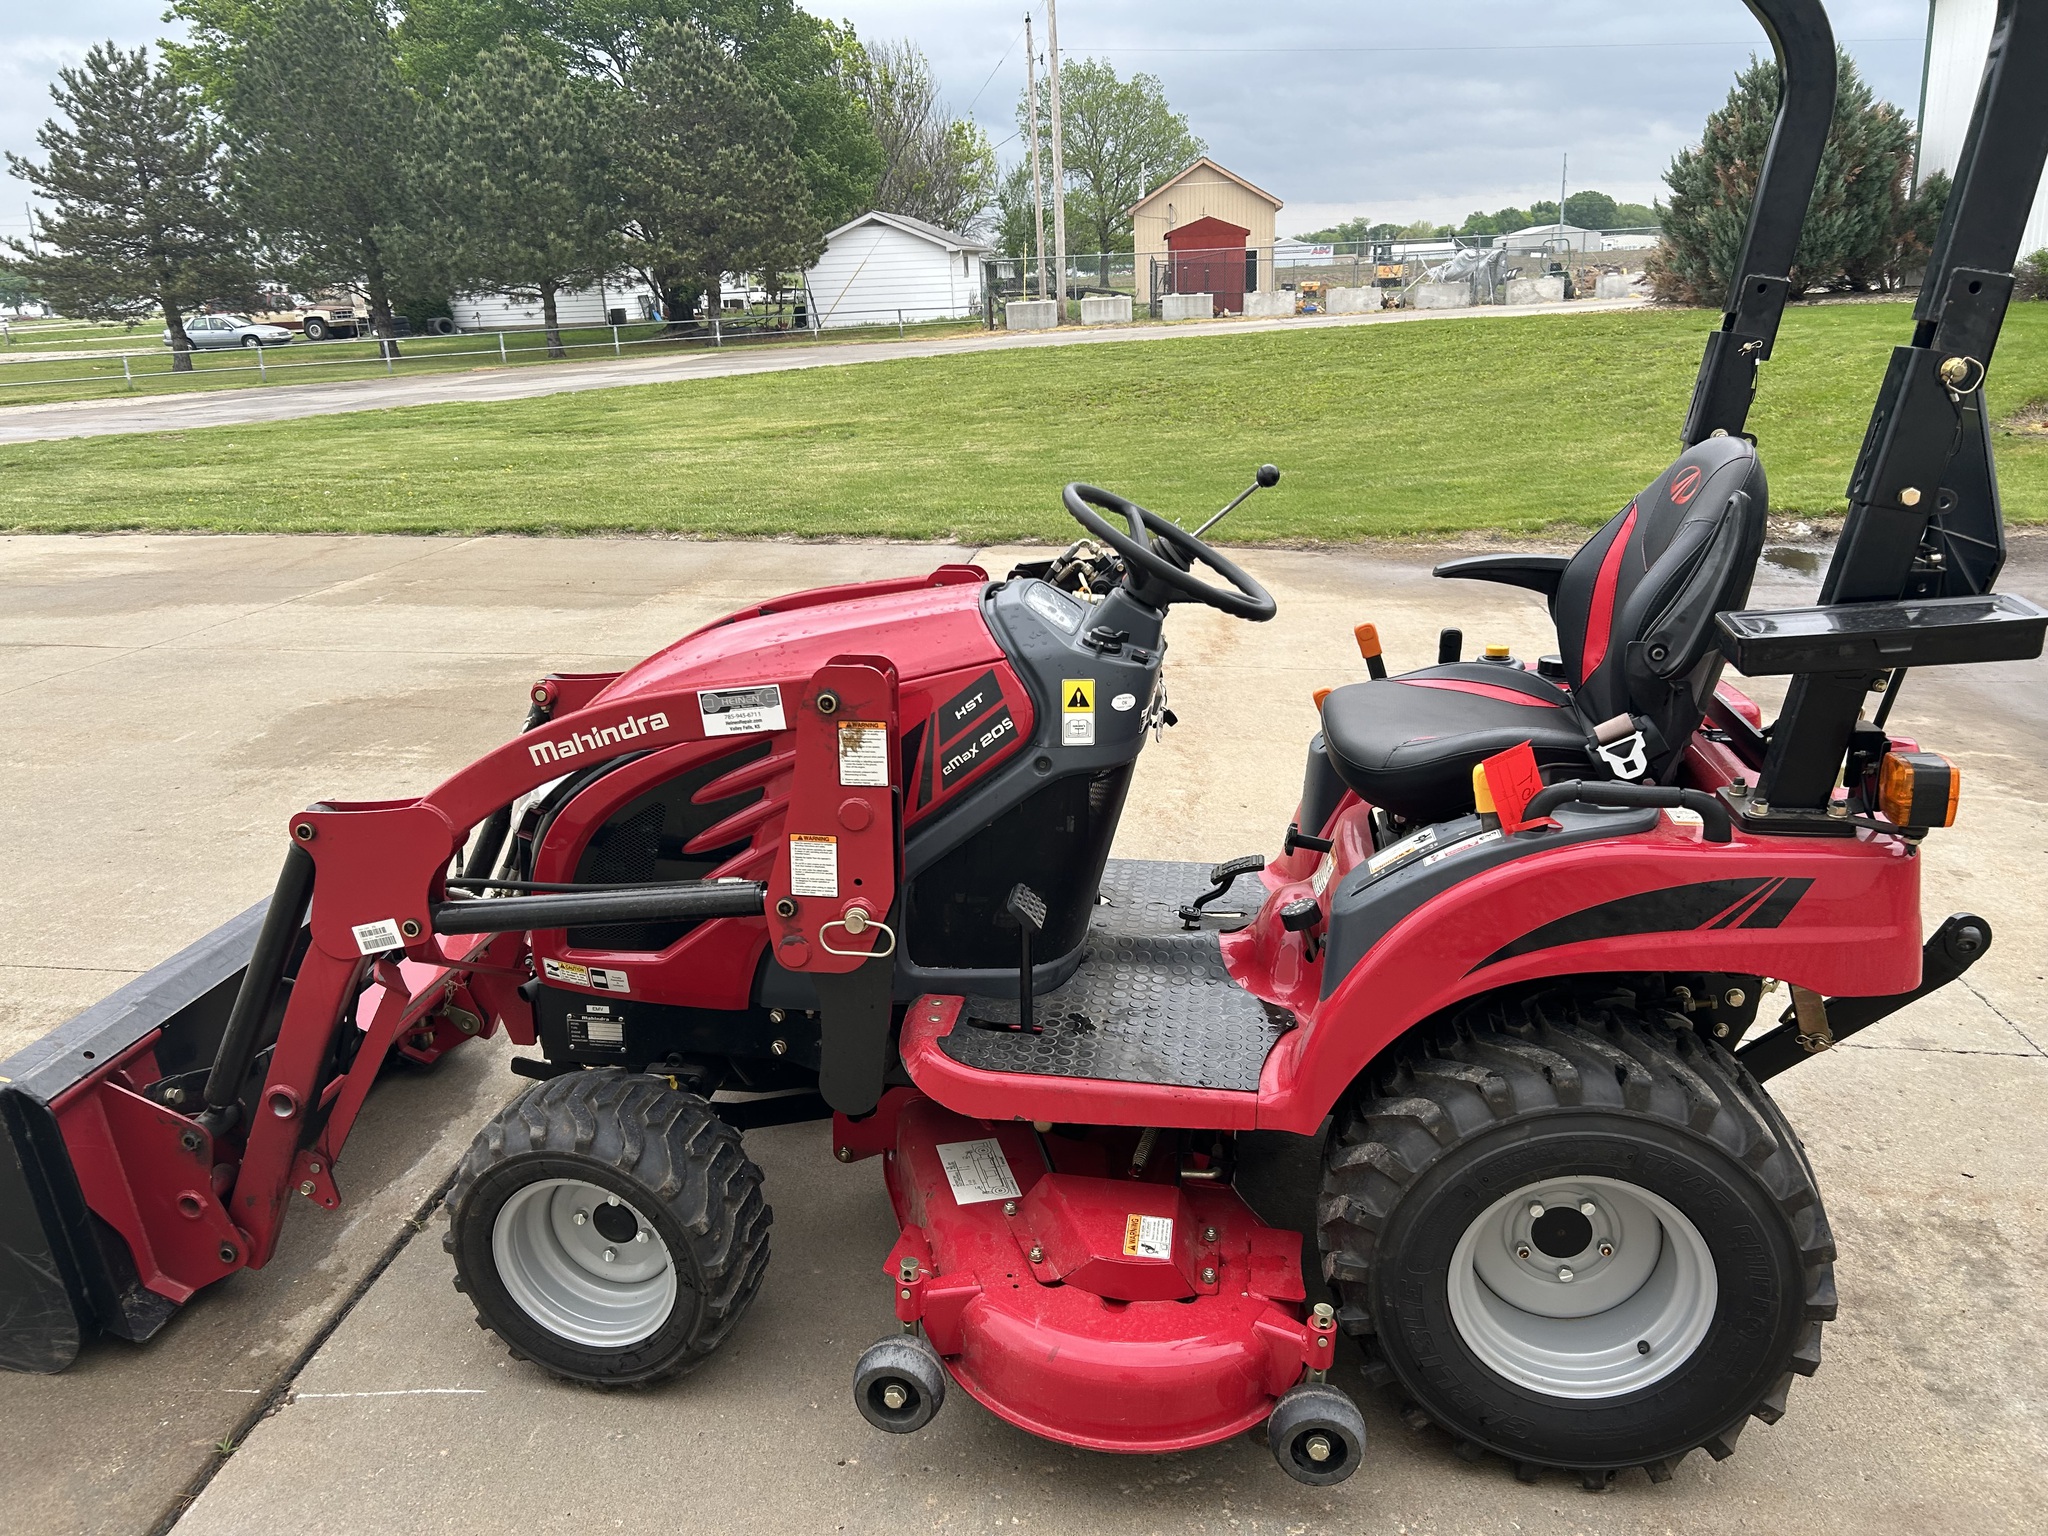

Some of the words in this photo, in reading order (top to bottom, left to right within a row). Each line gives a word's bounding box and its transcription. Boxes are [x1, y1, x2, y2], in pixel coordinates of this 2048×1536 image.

[721, 695, 760, 706] HEINEN
[954, 692, 983, 720] HST
[528, 711, 670, 767] Mahindra
[942, 742, 979, 776] eMax
[980, 717, 1014, 748] 20S
[1129, 1218, 1139, 1244] WARNING
